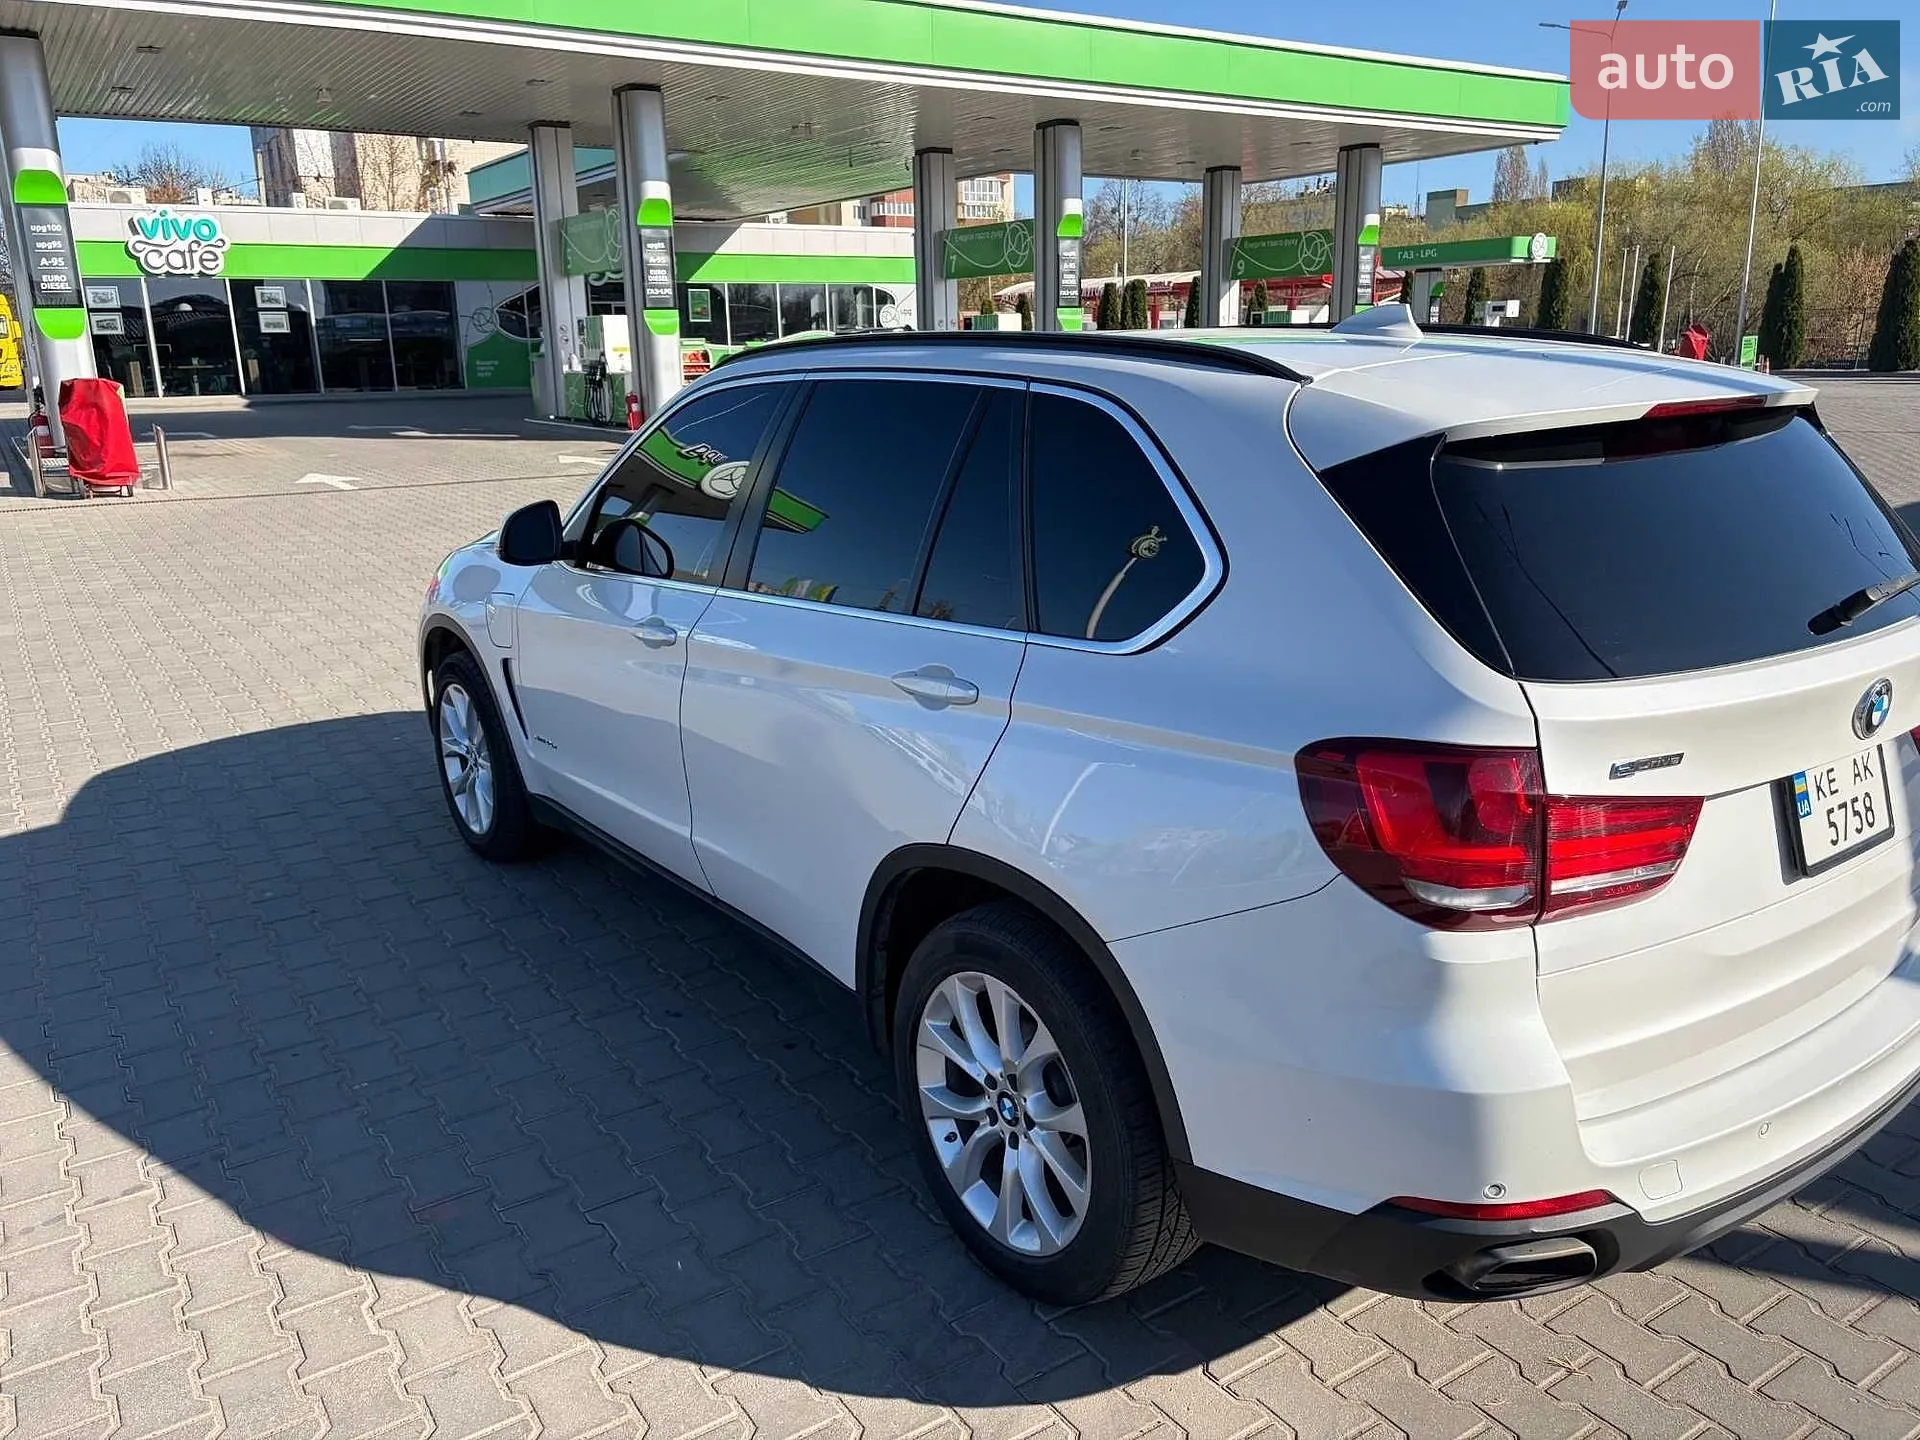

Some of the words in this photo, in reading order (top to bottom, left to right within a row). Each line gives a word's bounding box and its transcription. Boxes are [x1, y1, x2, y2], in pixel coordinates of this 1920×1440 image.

[30, 224, 62, 233] upg100
[137, 210, 217, 241] vivo
[36, 240, 62, 249] upg95
[1237, 259, 1245, 275] 9
[41, 274, 67, 282] EURO
[41, 282, 71, 290] DIESEL
[1814, 767, 1839, 801] KE
[1852, 751, 1874, 785] AK
[1797, 800, 1811, 816] UA
[1826, 791, 1875, 846] 5758
